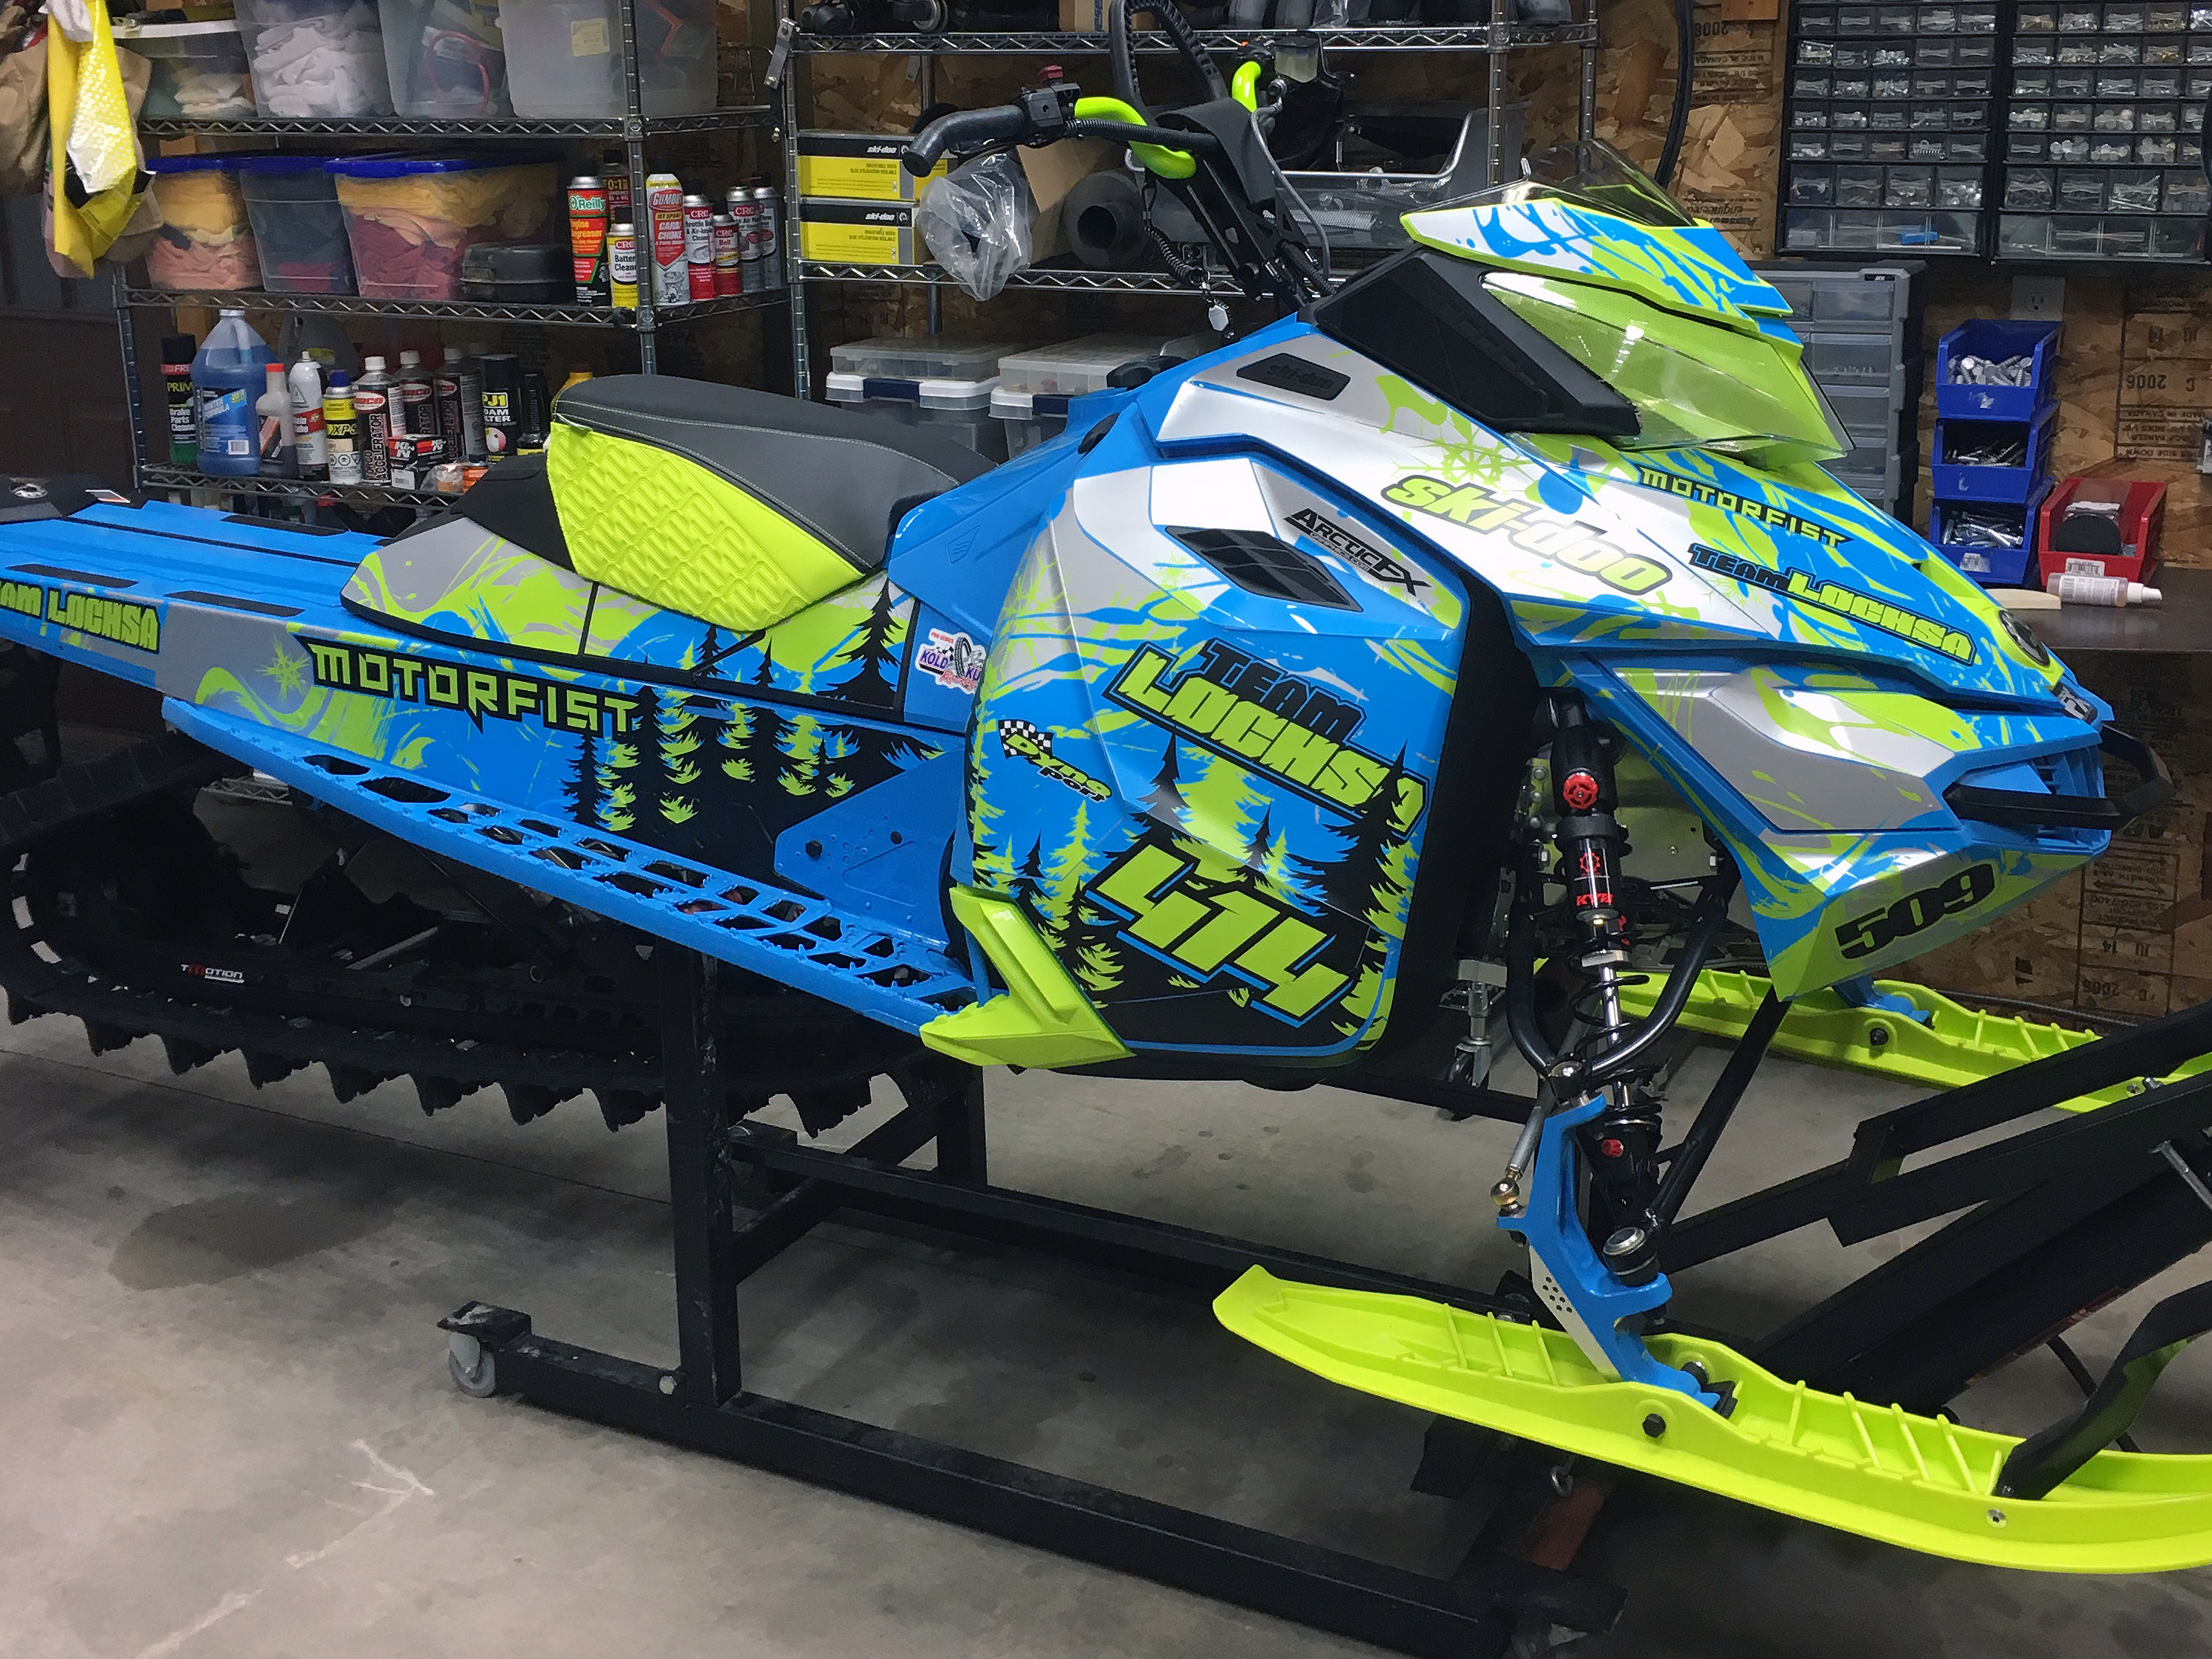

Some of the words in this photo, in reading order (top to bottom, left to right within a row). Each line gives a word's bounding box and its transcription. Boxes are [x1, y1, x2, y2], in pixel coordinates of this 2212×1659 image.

[569, 195, 606, 212] O'Reilly
[735, 207, 755, 217] CRC
[690, 210, 710, 219] CRC
[716, 230, 733, 238] CRC
[615, 241, 635, 250] CRC
[615, 255, 636, 263] Batter
[175, 364, 192, 372] FRE
[167, 383, 193, 392] PRIM
[2126, 374, 2167, 390] 2006
[441, 400, 458, 462] CCELERATOR
[369, 413, 389, 480] ACCELERATOR
[394, 441, 415, 459] K&N
[1641, 467, 1850, 548] MOTORFIST
[1382, 475, 1673, 595] ski-doo
[1691, 544, 1789, 592] TEAM
[1785, 571, 1975, 663] LOCHSA
[0, 581, 42, 618] AM
[47, 587, 159, 652] LOCHSA
[920, 649, 949, 669] KOLD
[306, 642, 640, 734] MOTORFIST
[1202, 639, 1364, 743] TEAM
[1115, 649, 1427, 835] LOCHSA
[1834, 863, 1996, 960] 509
[2101, 939, 2118, 955] 14
[2081, 978, 2121, 999] 2006
